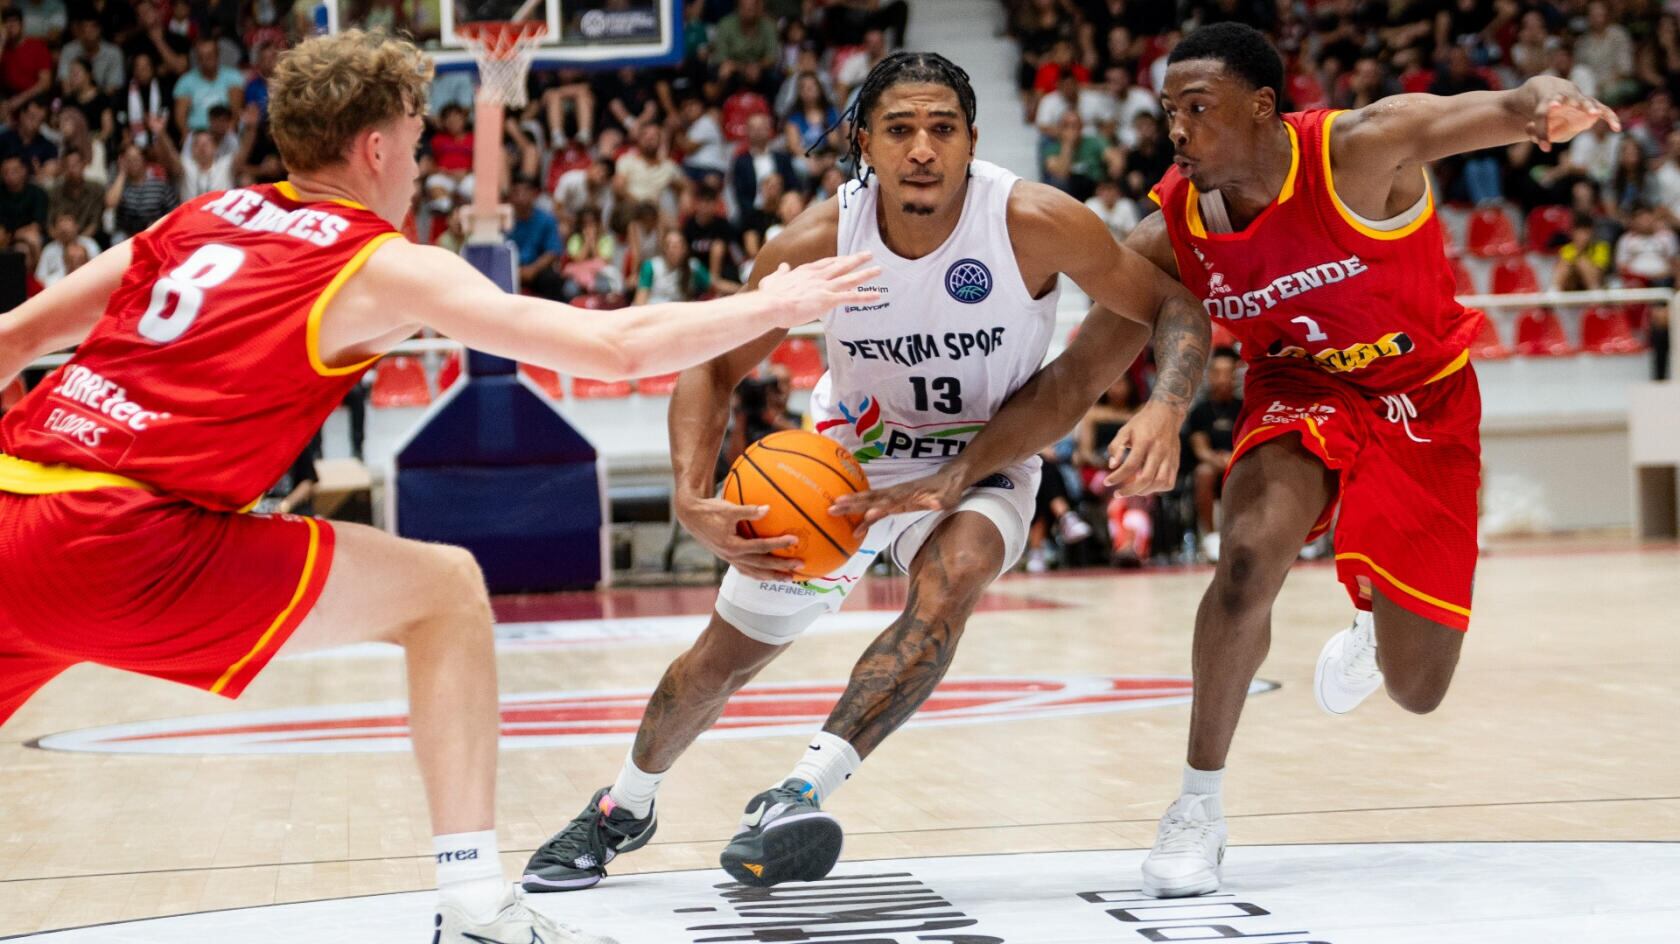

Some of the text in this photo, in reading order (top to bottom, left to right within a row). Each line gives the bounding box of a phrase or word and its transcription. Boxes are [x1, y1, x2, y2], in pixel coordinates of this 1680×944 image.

[138, 243, 245, 344] 8
[1290, 316, 1328, 342] 1
[909, 376, 962, 414] 13
[44, 408, 108, 447] FLOORS
[436, 848, 478, 863] rrea
